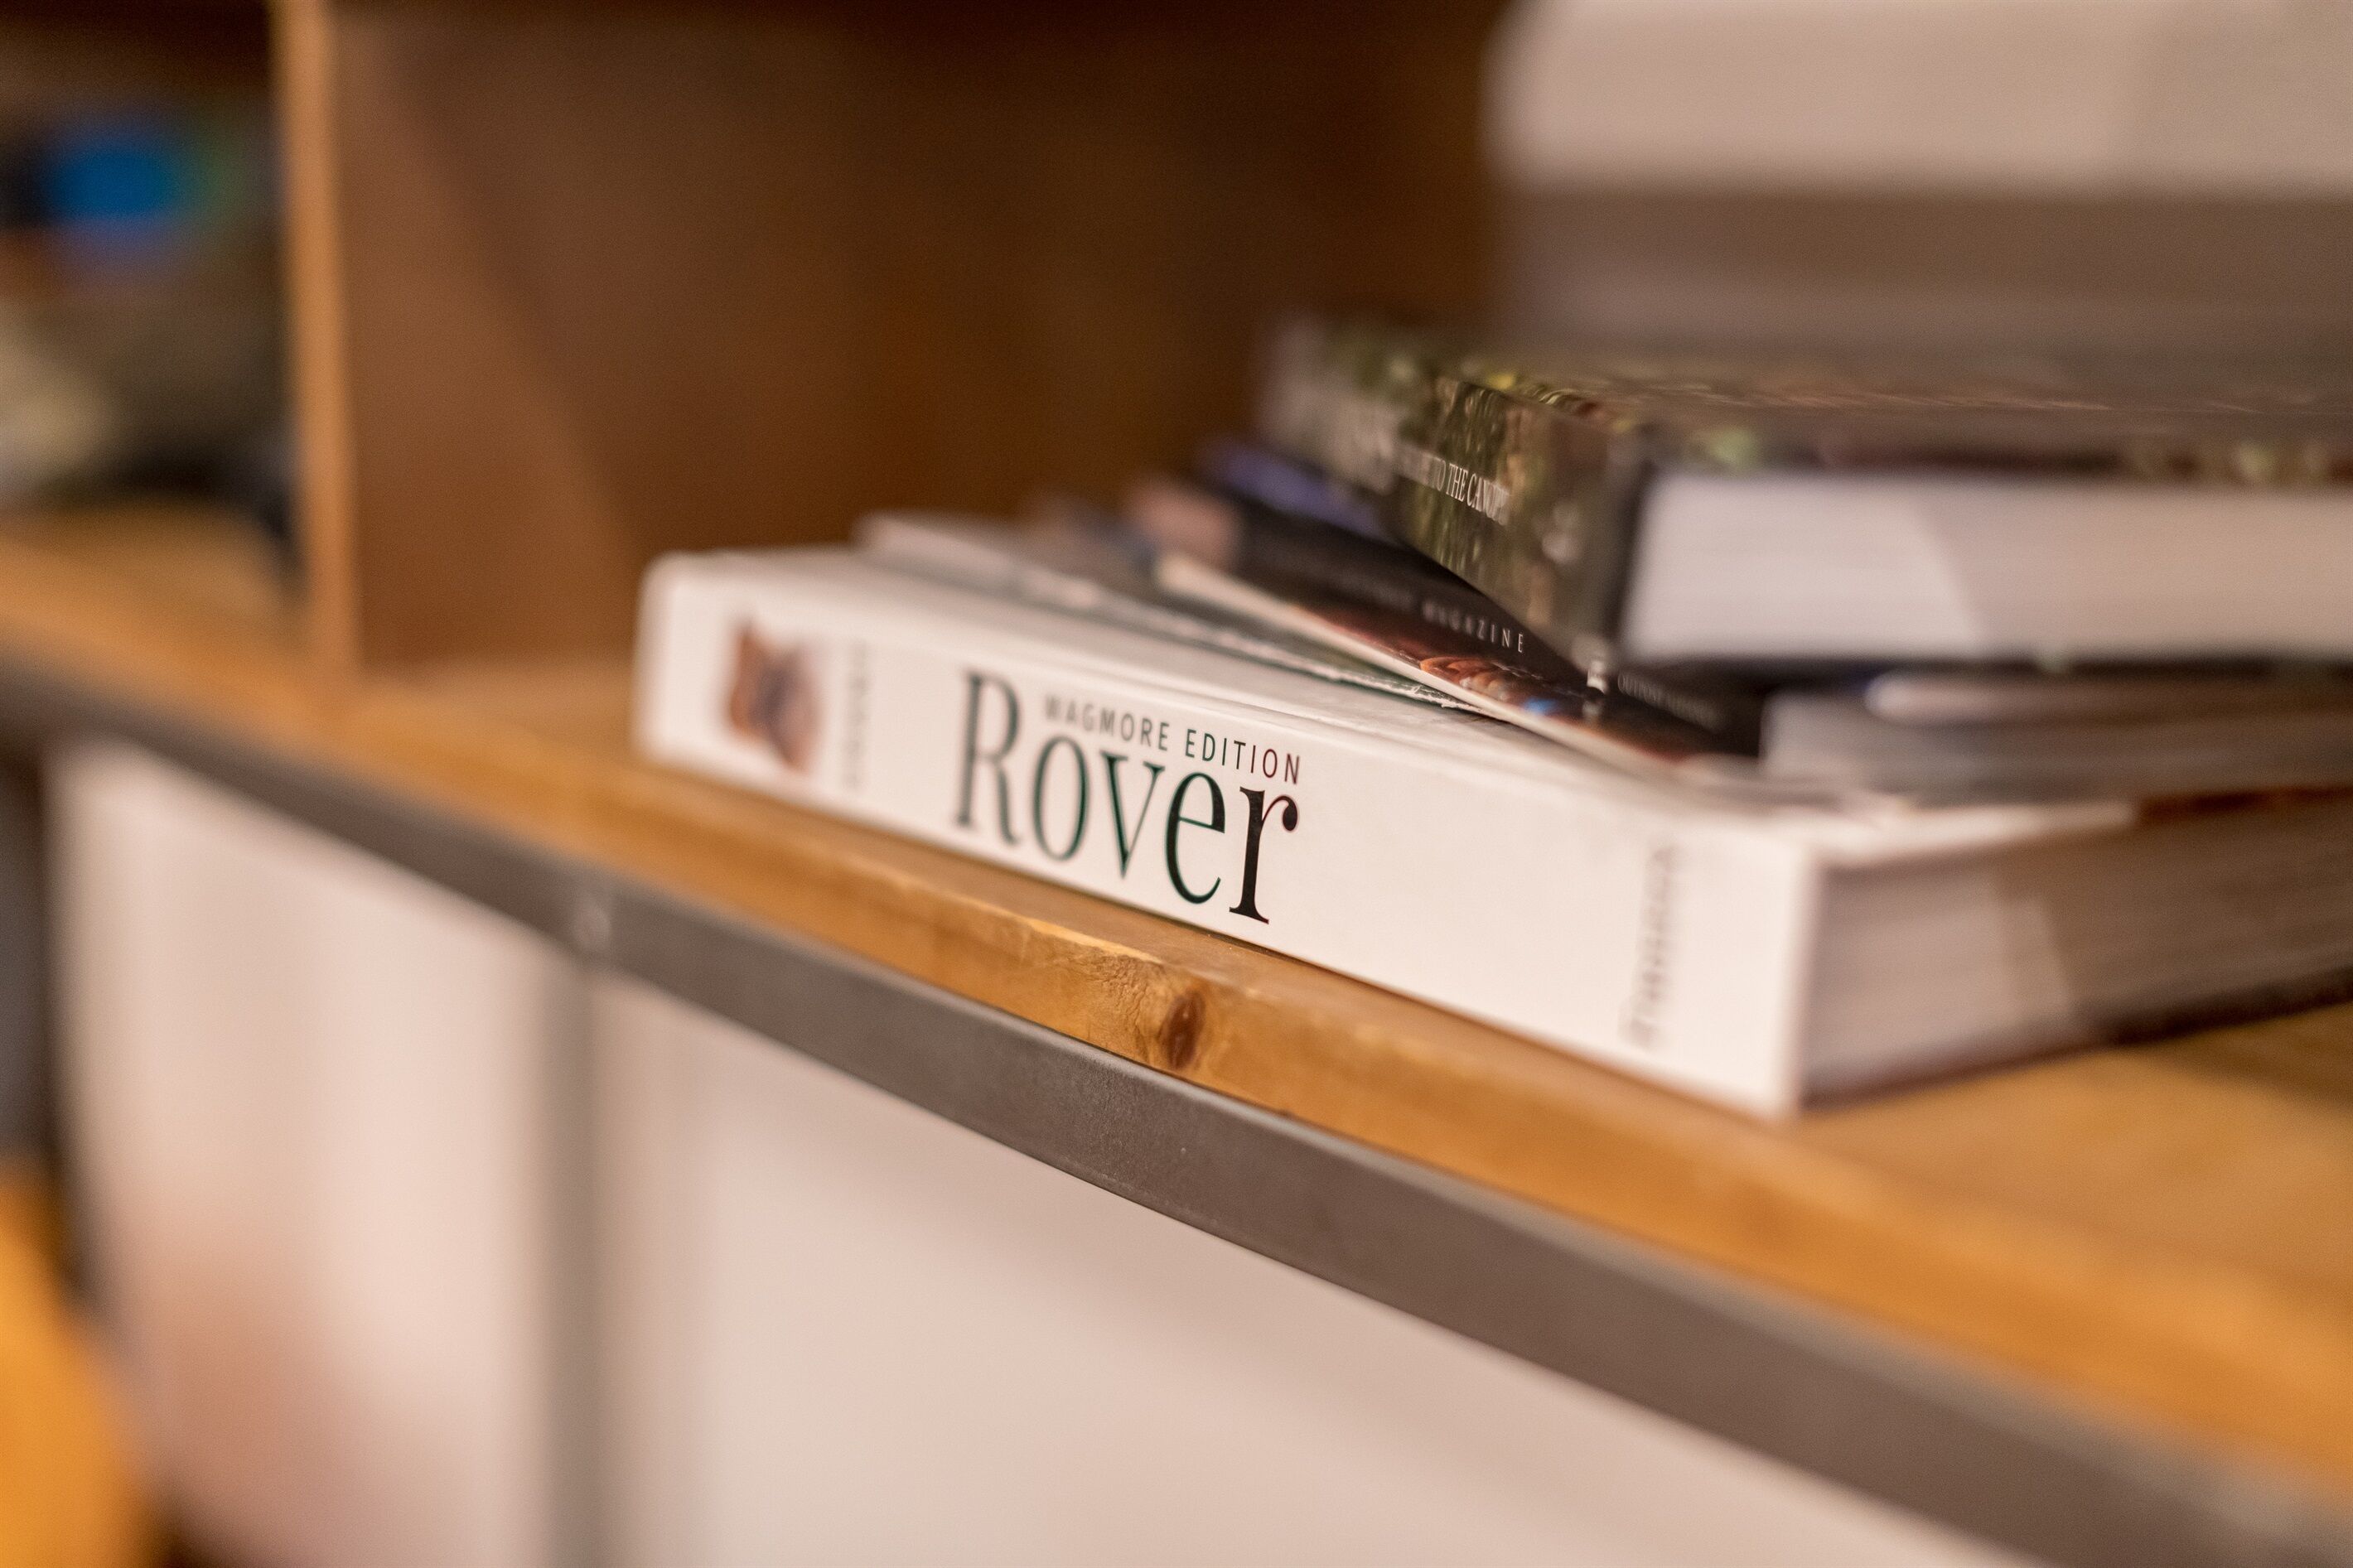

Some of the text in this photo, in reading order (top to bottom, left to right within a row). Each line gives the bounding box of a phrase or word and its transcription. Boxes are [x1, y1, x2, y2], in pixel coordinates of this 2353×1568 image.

[1446, 462, 1469, 503] THE
[1044, 694, 1300, 785] WAGMORE EDITION
[954, 668, 1299, 925] Rover
